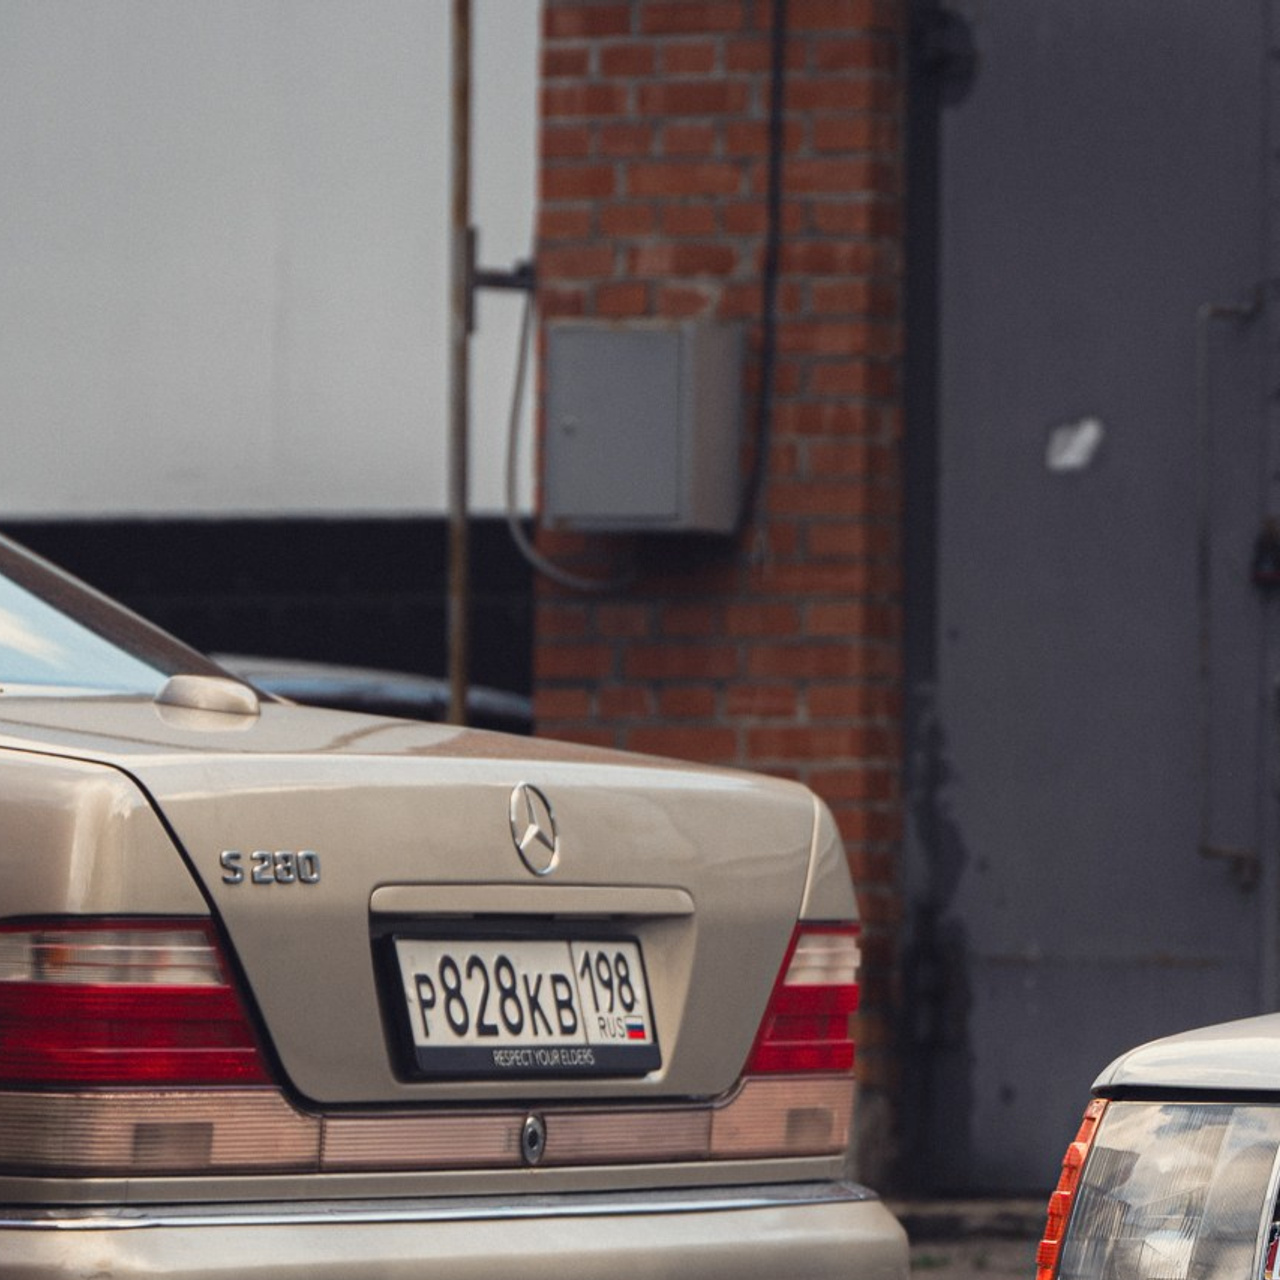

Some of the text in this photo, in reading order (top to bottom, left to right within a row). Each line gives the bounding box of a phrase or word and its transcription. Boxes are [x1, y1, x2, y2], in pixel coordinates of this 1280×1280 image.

[220, 850, 322, 885] S 280
[579, 949, 638, 1014] 198
[597, 1015, 626, 1039] RUS
[493, 1047, 596, 1067] RESPECT YOUR ELDERS
